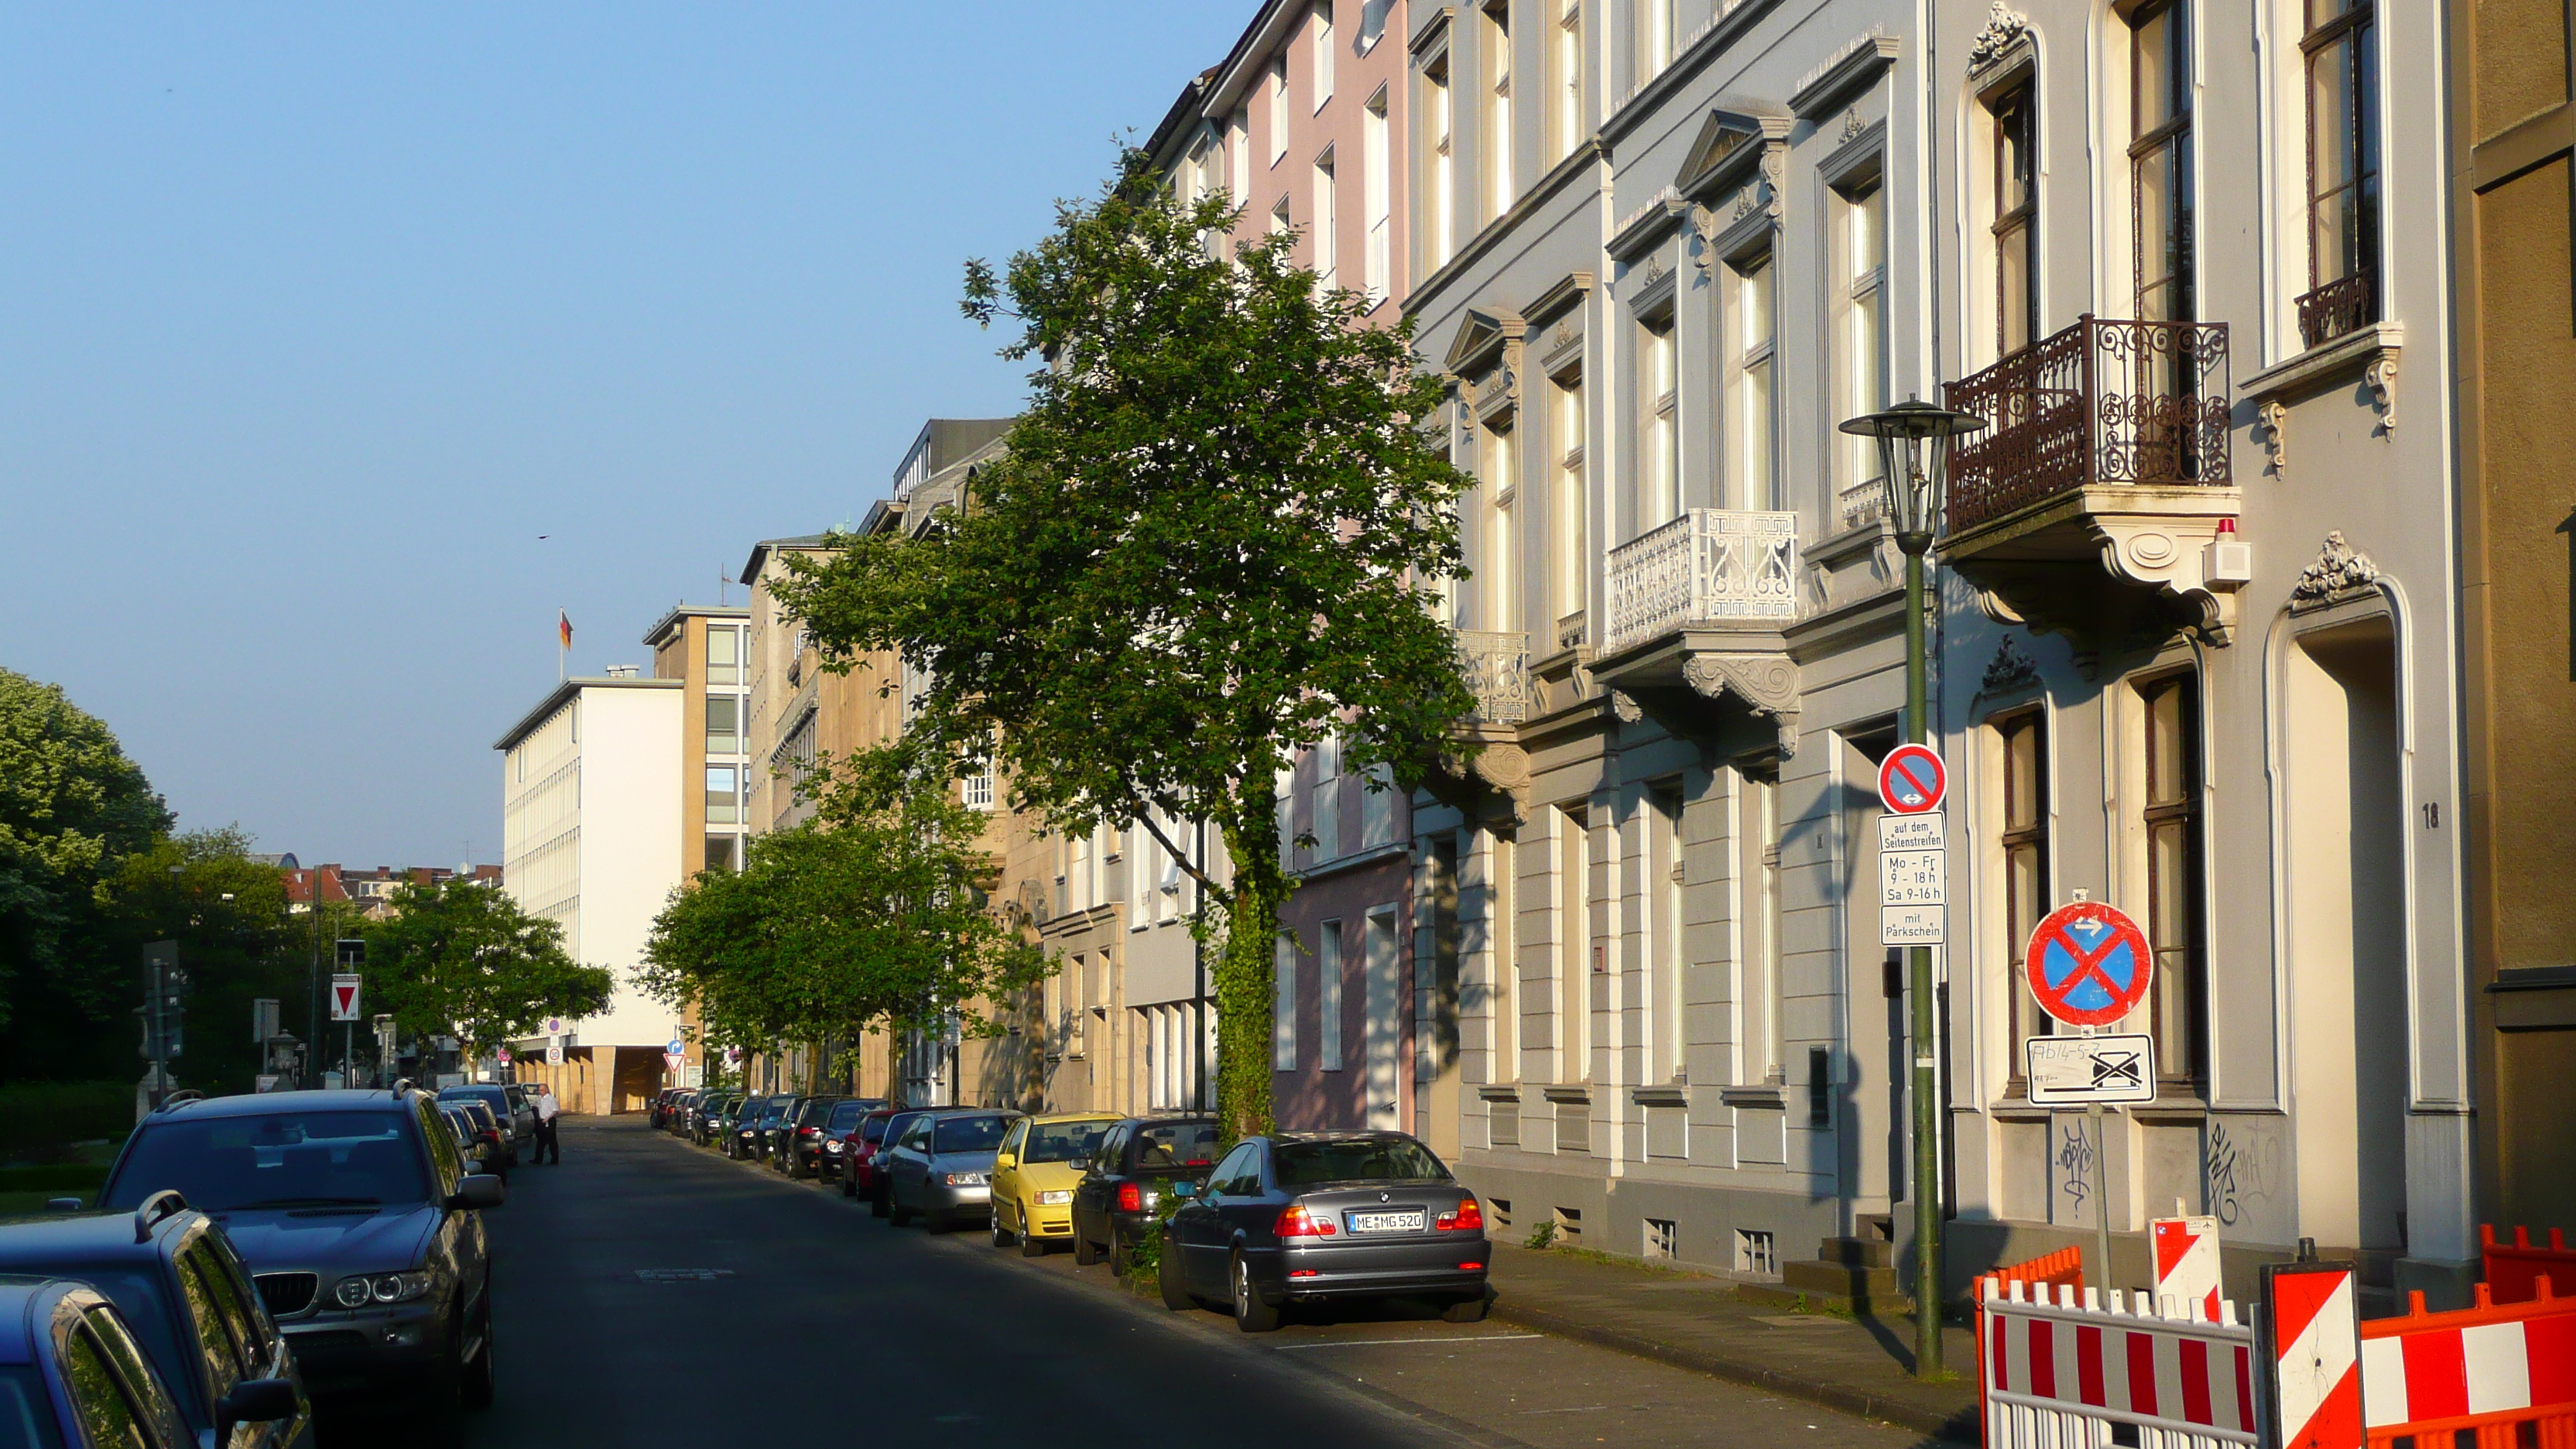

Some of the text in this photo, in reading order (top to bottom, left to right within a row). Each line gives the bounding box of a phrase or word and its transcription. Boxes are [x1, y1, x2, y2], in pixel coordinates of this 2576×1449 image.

[1894, 821, 1929, 834] auf dem
[1885, 834, 1941, 848] Seitenstreifen
[1889, 857, 1906, 868] Mo
[1923, 855, 1936, 868] Fr
[1891, 872, 1897, 885] 9
[1914, 872, 1926, 883] 18
[1929, 871, 1936, 883] h
[1888, 887, 1941, 900] Sa 9-16 h
[1905, 913, 1921, 923] mit
[1886, 926, 1941, 937] Parkschein
[1357, 1215, 1421, 1228] ME MG 520
